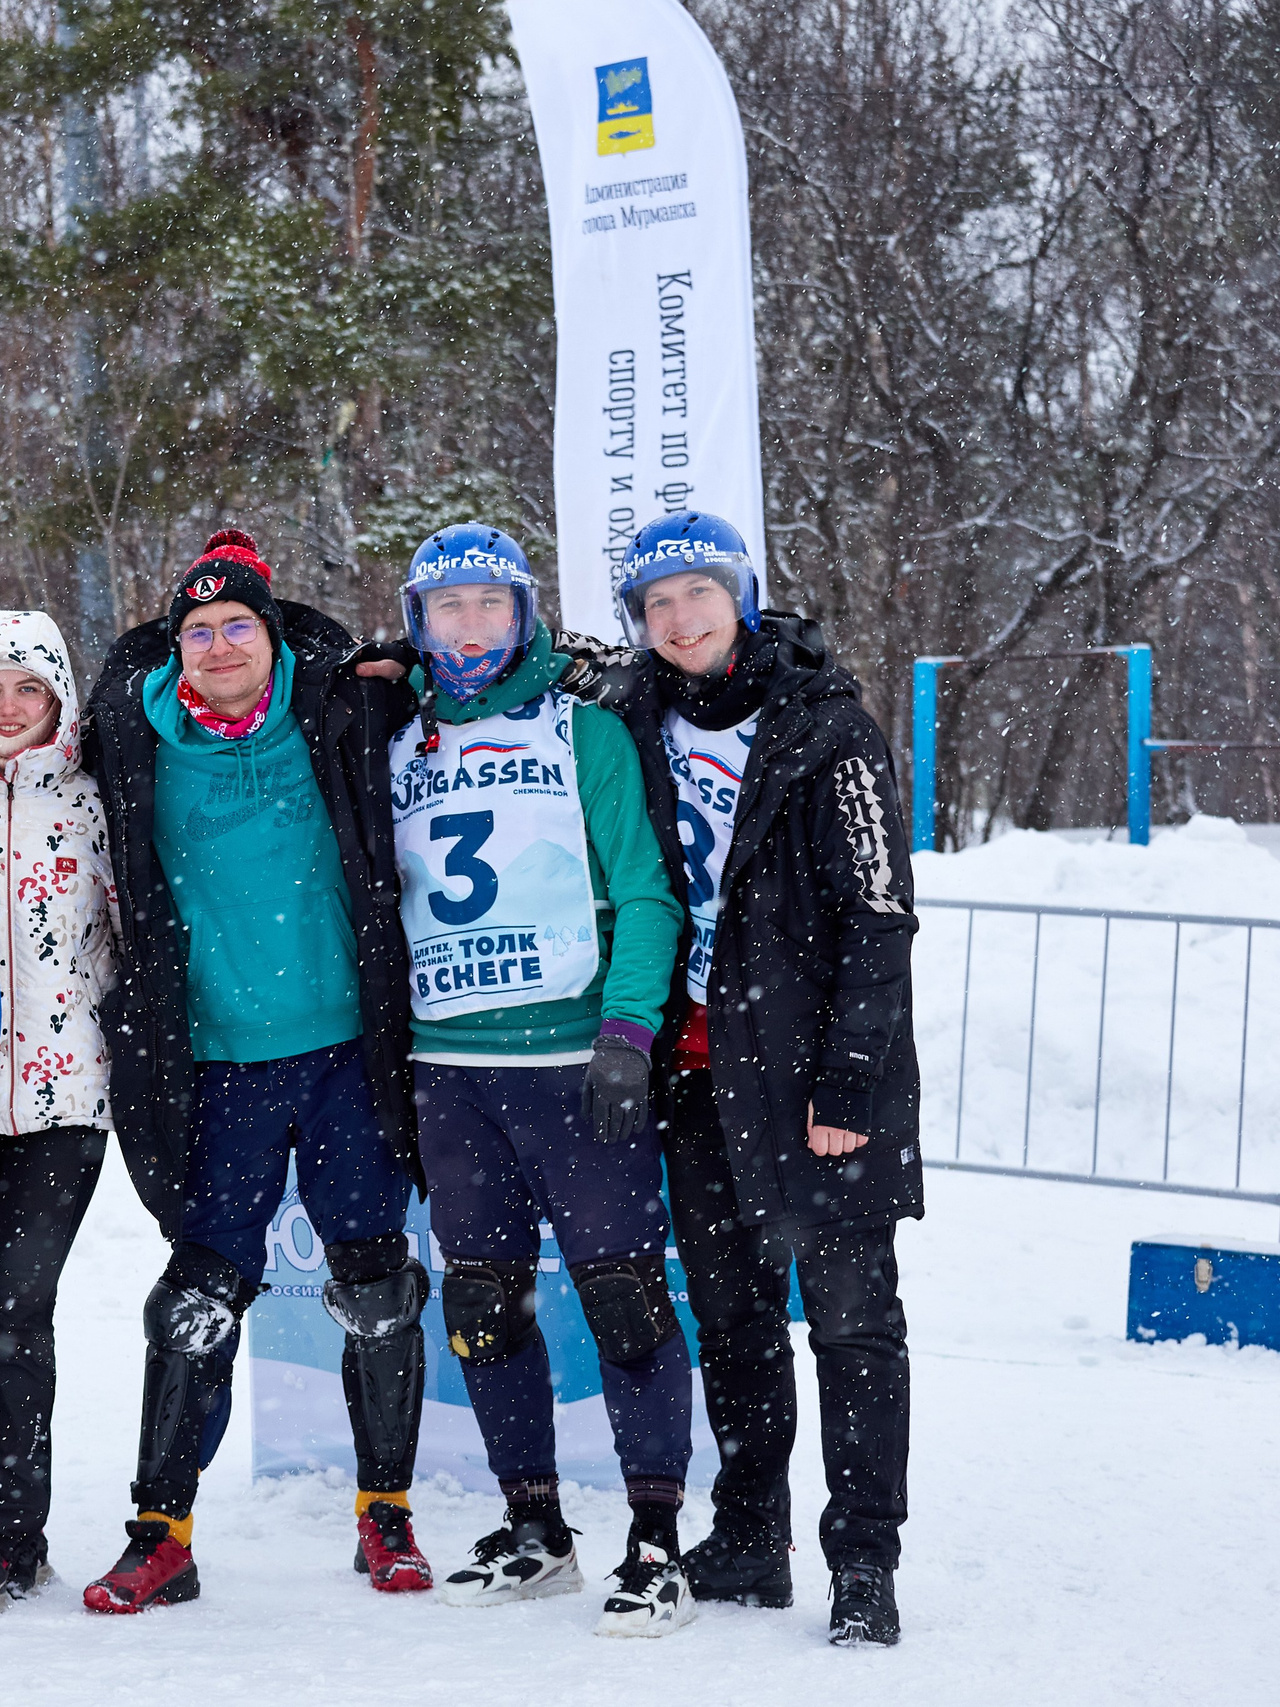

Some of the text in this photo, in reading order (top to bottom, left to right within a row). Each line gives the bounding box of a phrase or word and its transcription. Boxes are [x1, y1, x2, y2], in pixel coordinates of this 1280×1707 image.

[657, 269, 693, 418] Комитет
[603, 349, 636, 460] спорту
[661, 430, 690, 469] по
[610, 473, 633, 496] и
[428, 810, 498, 926] 3
[427, 954, 454, 968] ЗНАЕТ
[459, 932, 539, 959] ТОЛК
[416, 956, 543, 998] В СНЕГЕ
